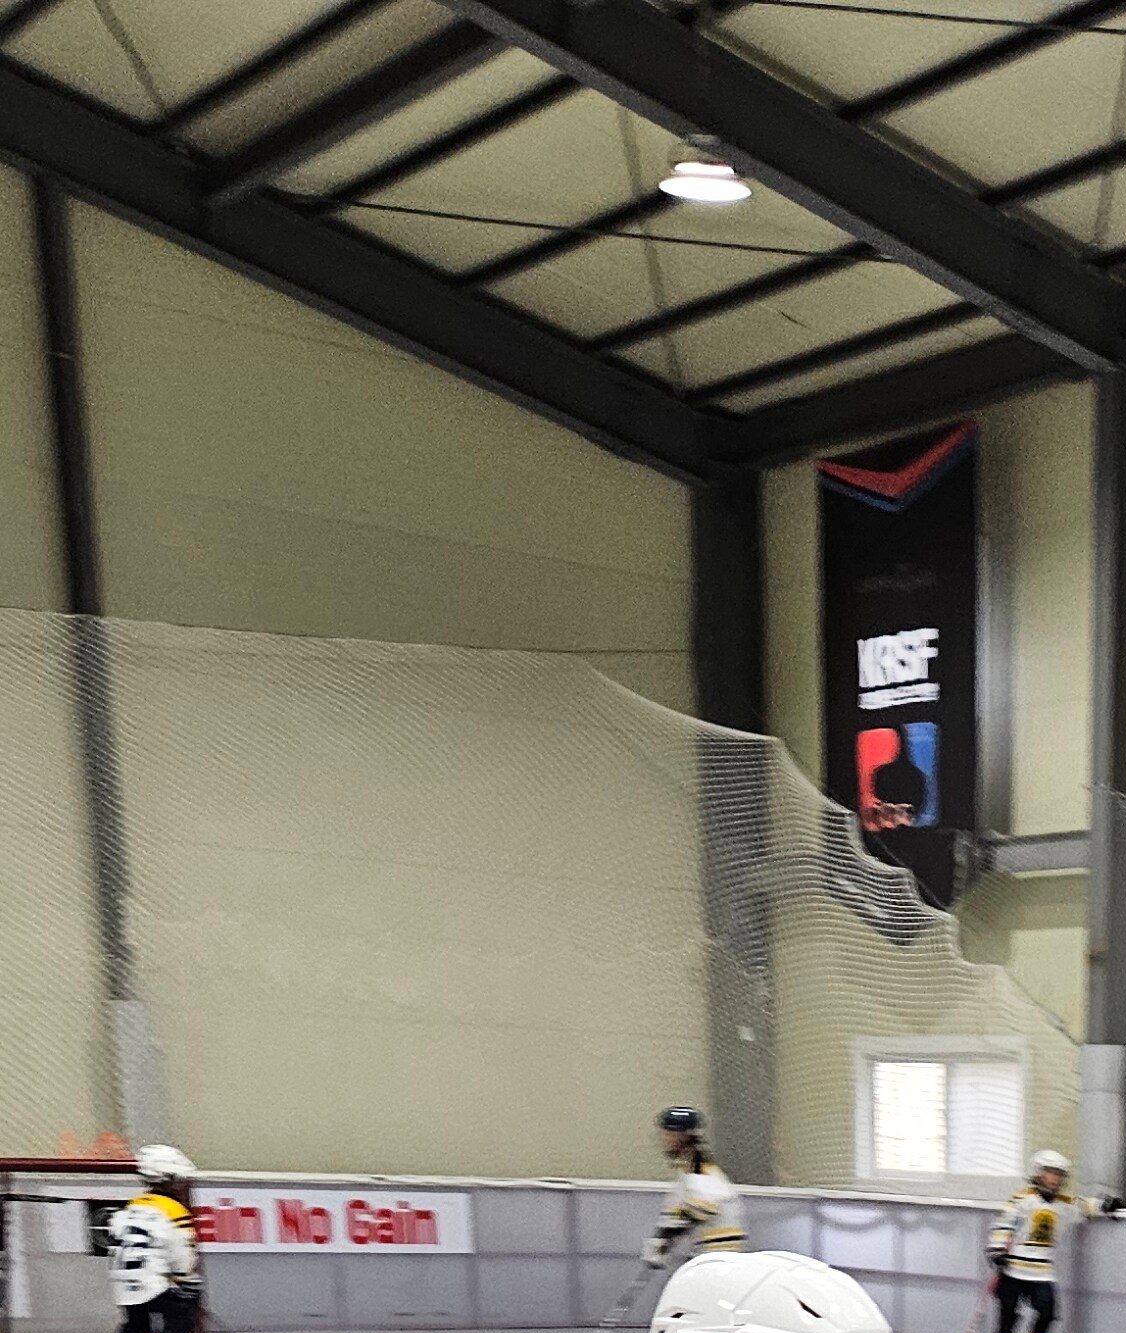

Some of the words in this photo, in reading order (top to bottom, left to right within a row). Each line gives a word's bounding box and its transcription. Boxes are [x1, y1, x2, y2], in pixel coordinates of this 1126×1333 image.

[193, 1197, 263, 1243] ain
[276, 1199, 332, 1244] No
[345, 1199, 440, 1244] Gain
